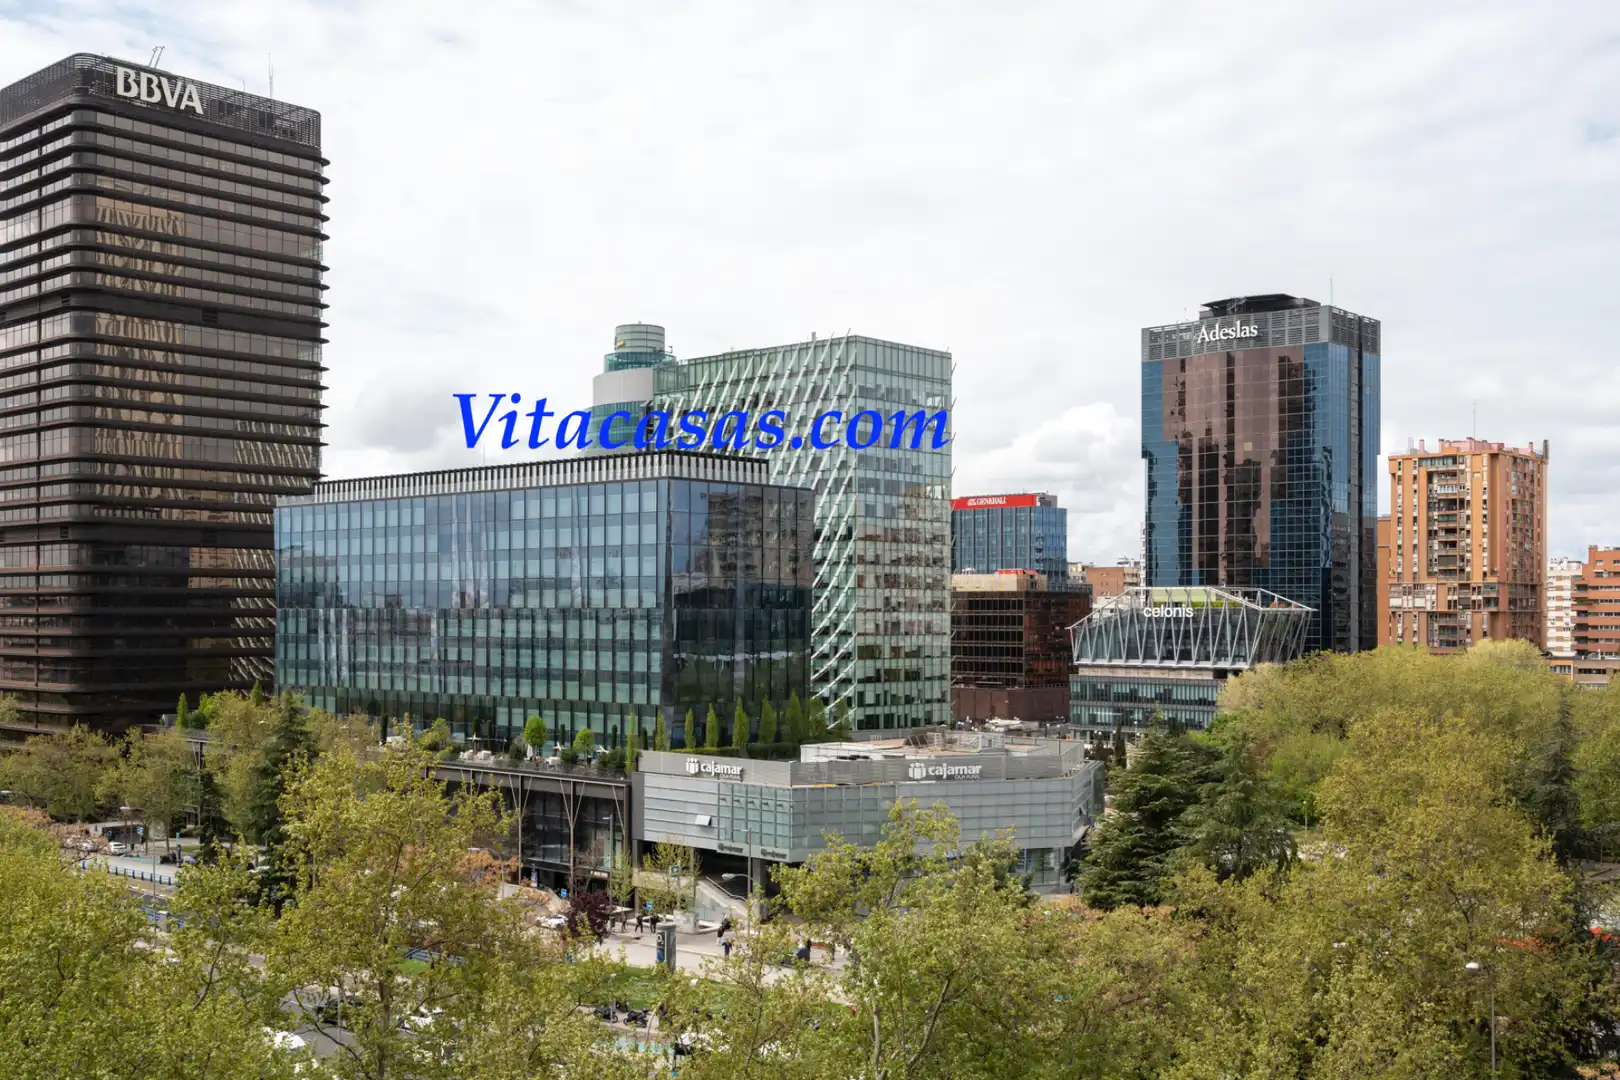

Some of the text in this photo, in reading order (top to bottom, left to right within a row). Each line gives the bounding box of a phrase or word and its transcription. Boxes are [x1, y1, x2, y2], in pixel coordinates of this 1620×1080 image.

[116, 66, 204, 114] BBVA
[1197, 320, 1258, 343] Adeslas
[1143, 603, 1194, 618] celonis
[700, 760, 743, 776] cajamar
[928, 762, 982, 779] cajamar
